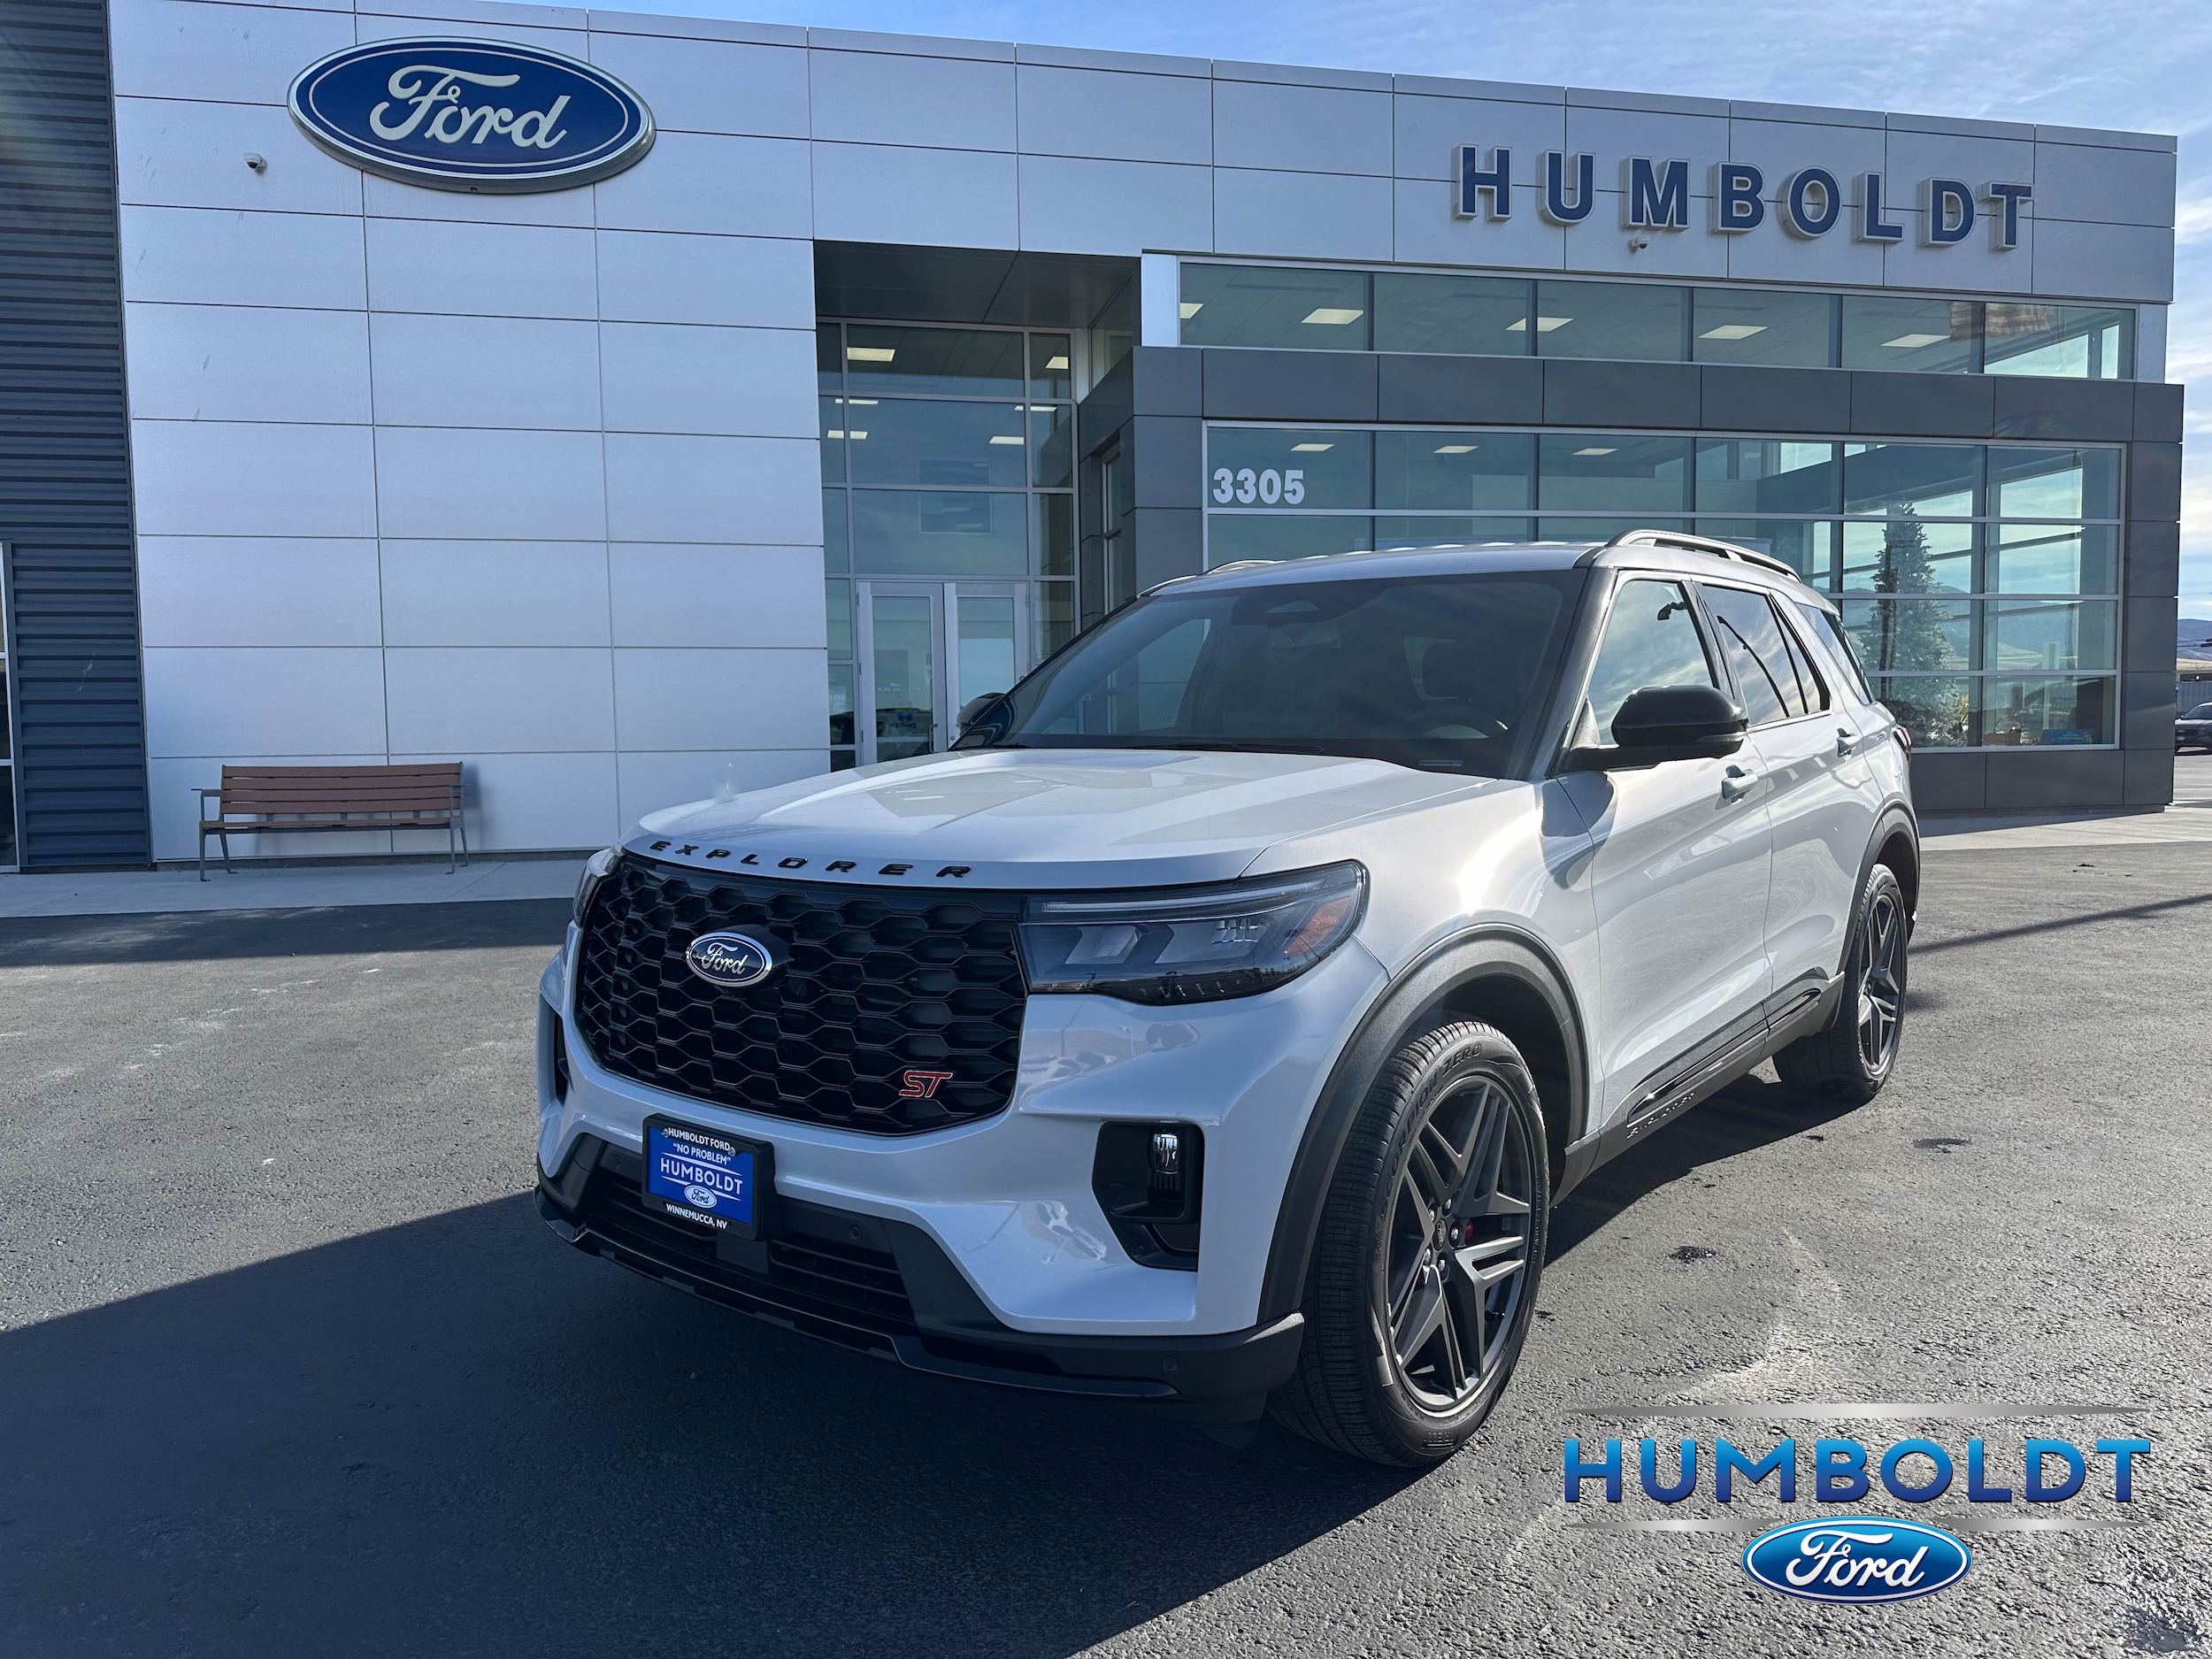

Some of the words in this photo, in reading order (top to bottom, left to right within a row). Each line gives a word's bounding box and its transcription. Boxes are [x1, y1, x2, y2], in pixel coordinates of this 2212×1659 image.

[368, 64, 572, 150] Ford
[1453, 143, 2033, 251] HUMBOLDT
[1212, 467, 1305, 504] 3305
[649, 841, 972, 878] EXPLORER
[701, 941, 749, 975] Ford
[1442, 1042, 1482, 1077] ZERO
[898, 1070, 954, 1098] ST
[668, 1127, 710, 1146] HUMBOLDT
[710, 1136, 731, 1151] FORD
[660, 1157, 743, 1194] HUMBOLDT
[691, 1188, 710, 1204] Ford
[666, 1203, 716, 1228] WINNEMUCCA,
[717, 1218, 727, 1230] NV
